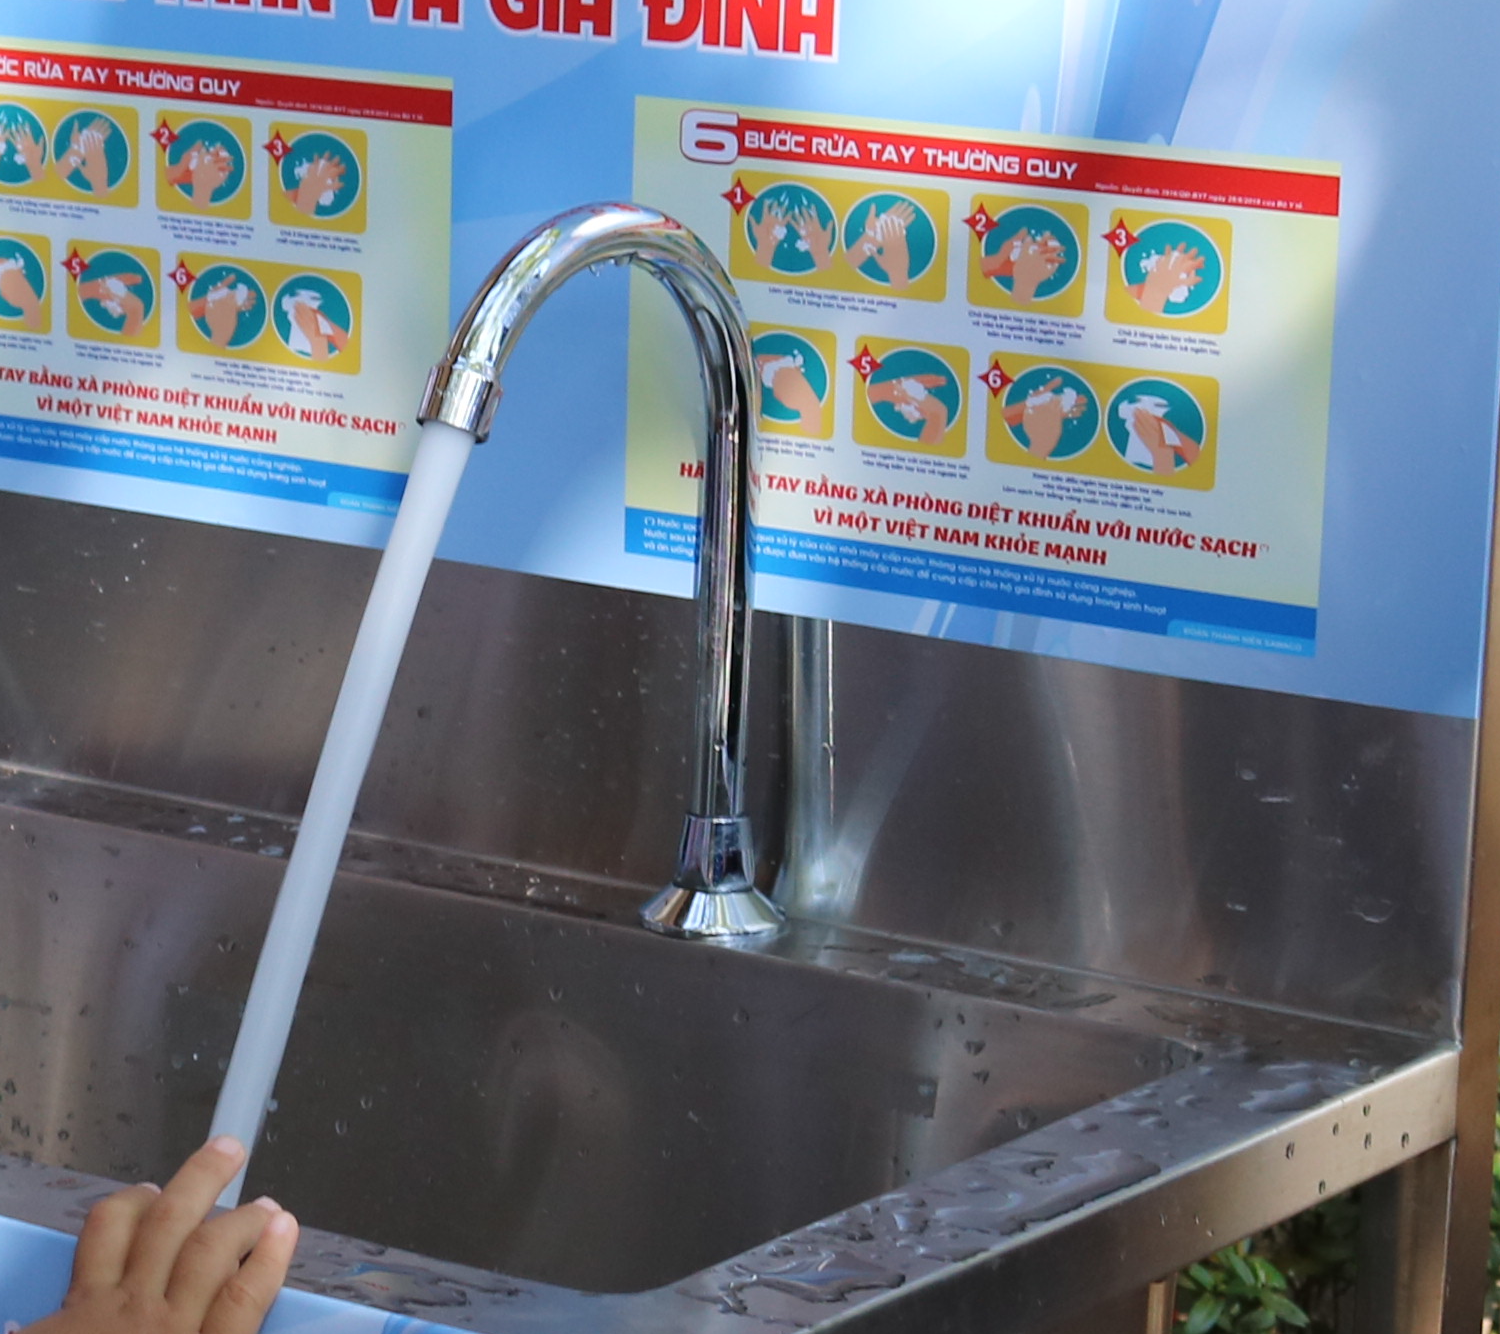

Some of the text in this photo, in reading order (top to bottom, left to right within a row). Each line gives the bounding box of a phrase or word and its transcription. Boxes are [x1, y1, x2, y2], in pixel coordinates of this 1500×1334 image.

[22, 56, 65, 81] RỬA
[68, 64, 109, 85] TAY
[114, 68, 195, 93] THƯỜNG
[198, 77, 241, 97] QUY
[159, 128, 169, 145] 2
[273, 139, 283, 156] 3
[681, 111, 1078, 181] 6 BƯỚC RỬA TAY THƯỜNG QUY
[733, 187, 743, 204] 1
[975, 214, 986, 232] 2
[1115, 229, 1127, 247] 3
[71, 259, 80, 275] 5
[176, 269, 187, 285] 6
[859, 357, 870, 373] 5
[989, 371, 1000, 388] 6
[29, 371, 72, 389] BẰNG
[78, 377, 100, 392] XÀ
[102, 380, 161, 402] PHÒNG
[163, 388, 201, 407] DIỆT
[203, 394, 265, 416] KHUẨN
[267, 401, 298, 421] VỚI
[299, 408, 347, 429] NƯỚC
[351, 415, 399, 435] SẠCH
[38, 397, 280, 443] VÌ MỘT VIỆT NAM KHỎE MẠNH
[679, 461, 1258, 557] HÃ TAY BẰNG XÀ PHÒNG DIỆT KHUẨN VỚI NƯỚC SẠCH
[814, 508, 1108, 565] VÌ MỘT VIỆT NAM KHỎE MẠNH
